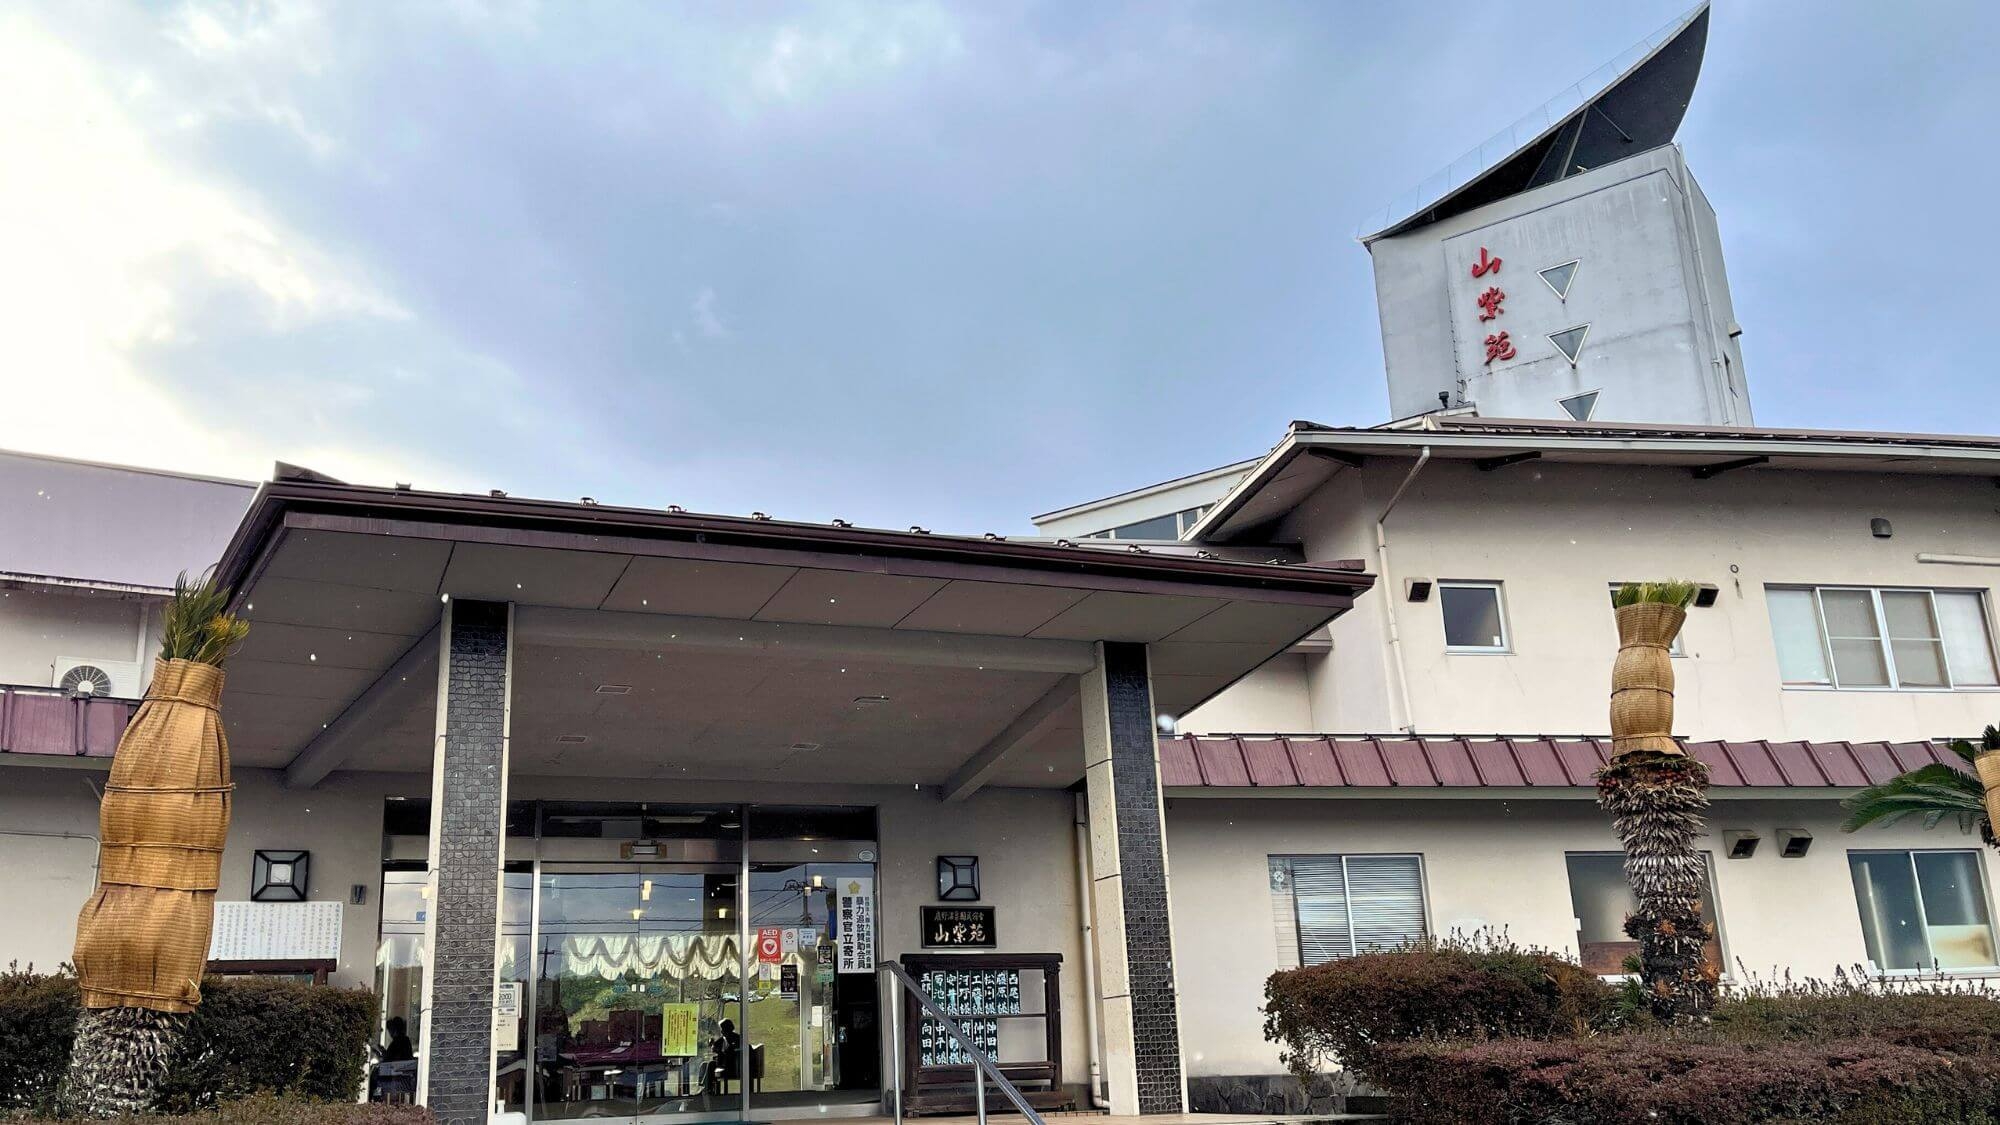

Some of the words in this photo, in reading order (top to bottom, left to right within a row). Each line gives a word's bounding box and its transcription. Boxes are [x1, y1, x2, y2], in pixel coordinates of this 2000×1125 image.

[1471, 246, 1517, 365] 山紫苑
[842, 896, 854, 969] 警察官立寄所
[856, 896, 866, 969] 暴力追放賛助会員
[934, 922, 986, 943] 山紫苑
